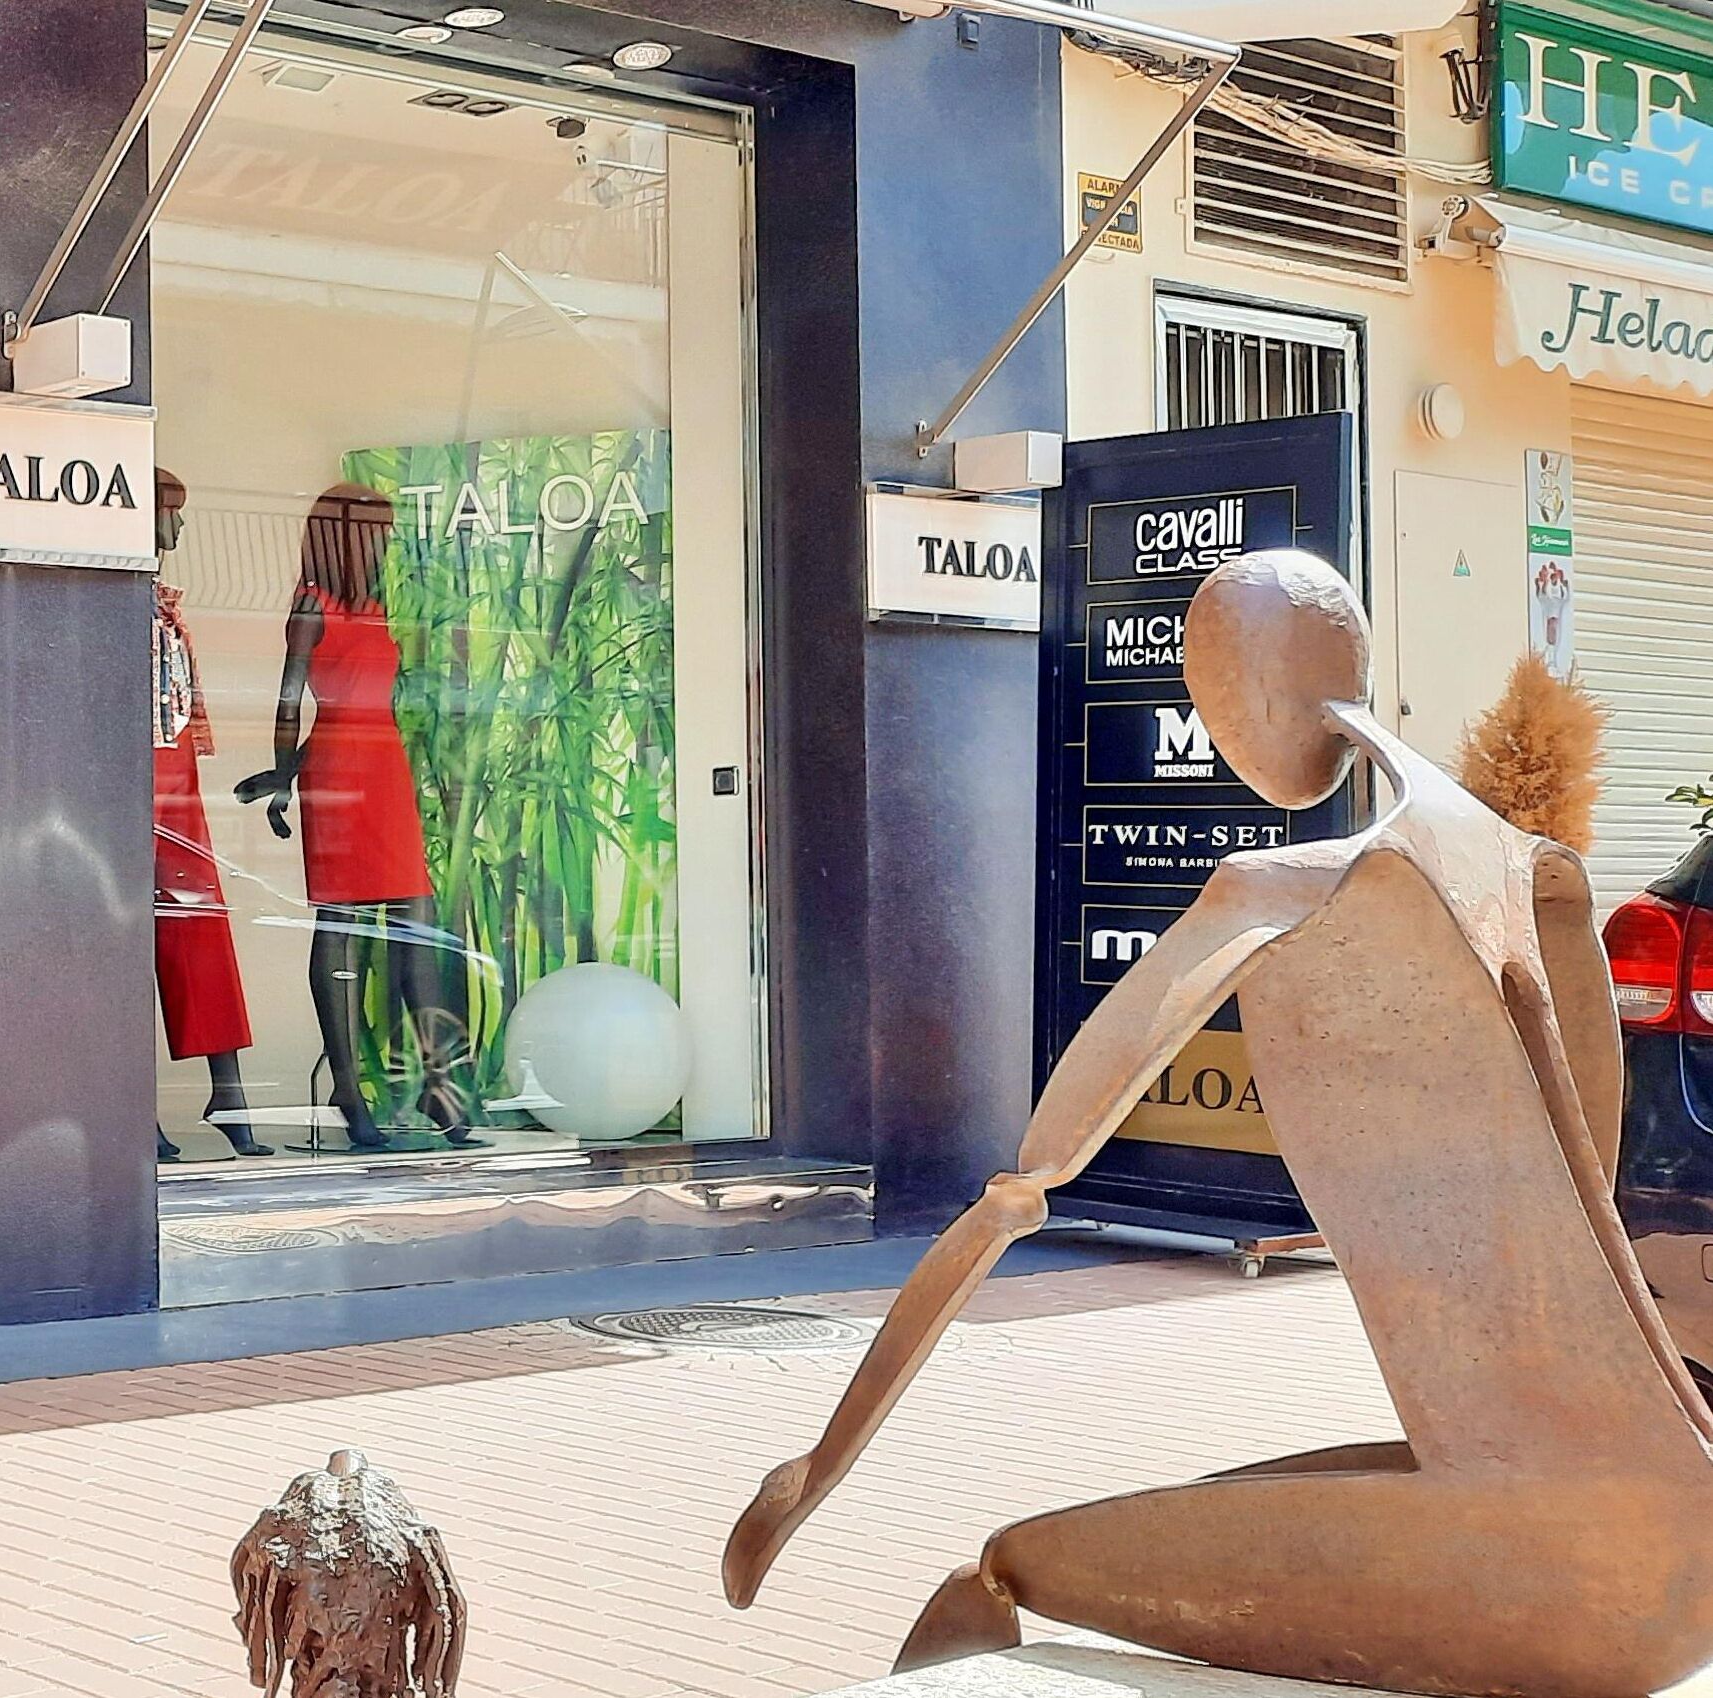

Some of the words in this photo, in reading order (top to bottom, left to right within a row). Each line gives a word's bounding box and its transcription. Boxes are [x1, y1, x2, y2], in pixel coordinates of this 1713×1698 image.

[1514, 32, 1700, 165] HE
[1087, 178, 1123, 194] ALAR
[1568, 155, 1640, 194] ICE
[399, 471, 649, 540] TALOA
[918, 536, 1038, 582] TALOA
[1106, 647, 1185, 667] MICHAE
[1154, 764, 1214, 778] MISSONI
[1088, 824, 1284, 847] TWIN-SET
[1125, 856, 1174, 868] SIMONA
[1179, 857, 1218, 868] BARBI
[1139, 1065, 1264, 1114] LOA
